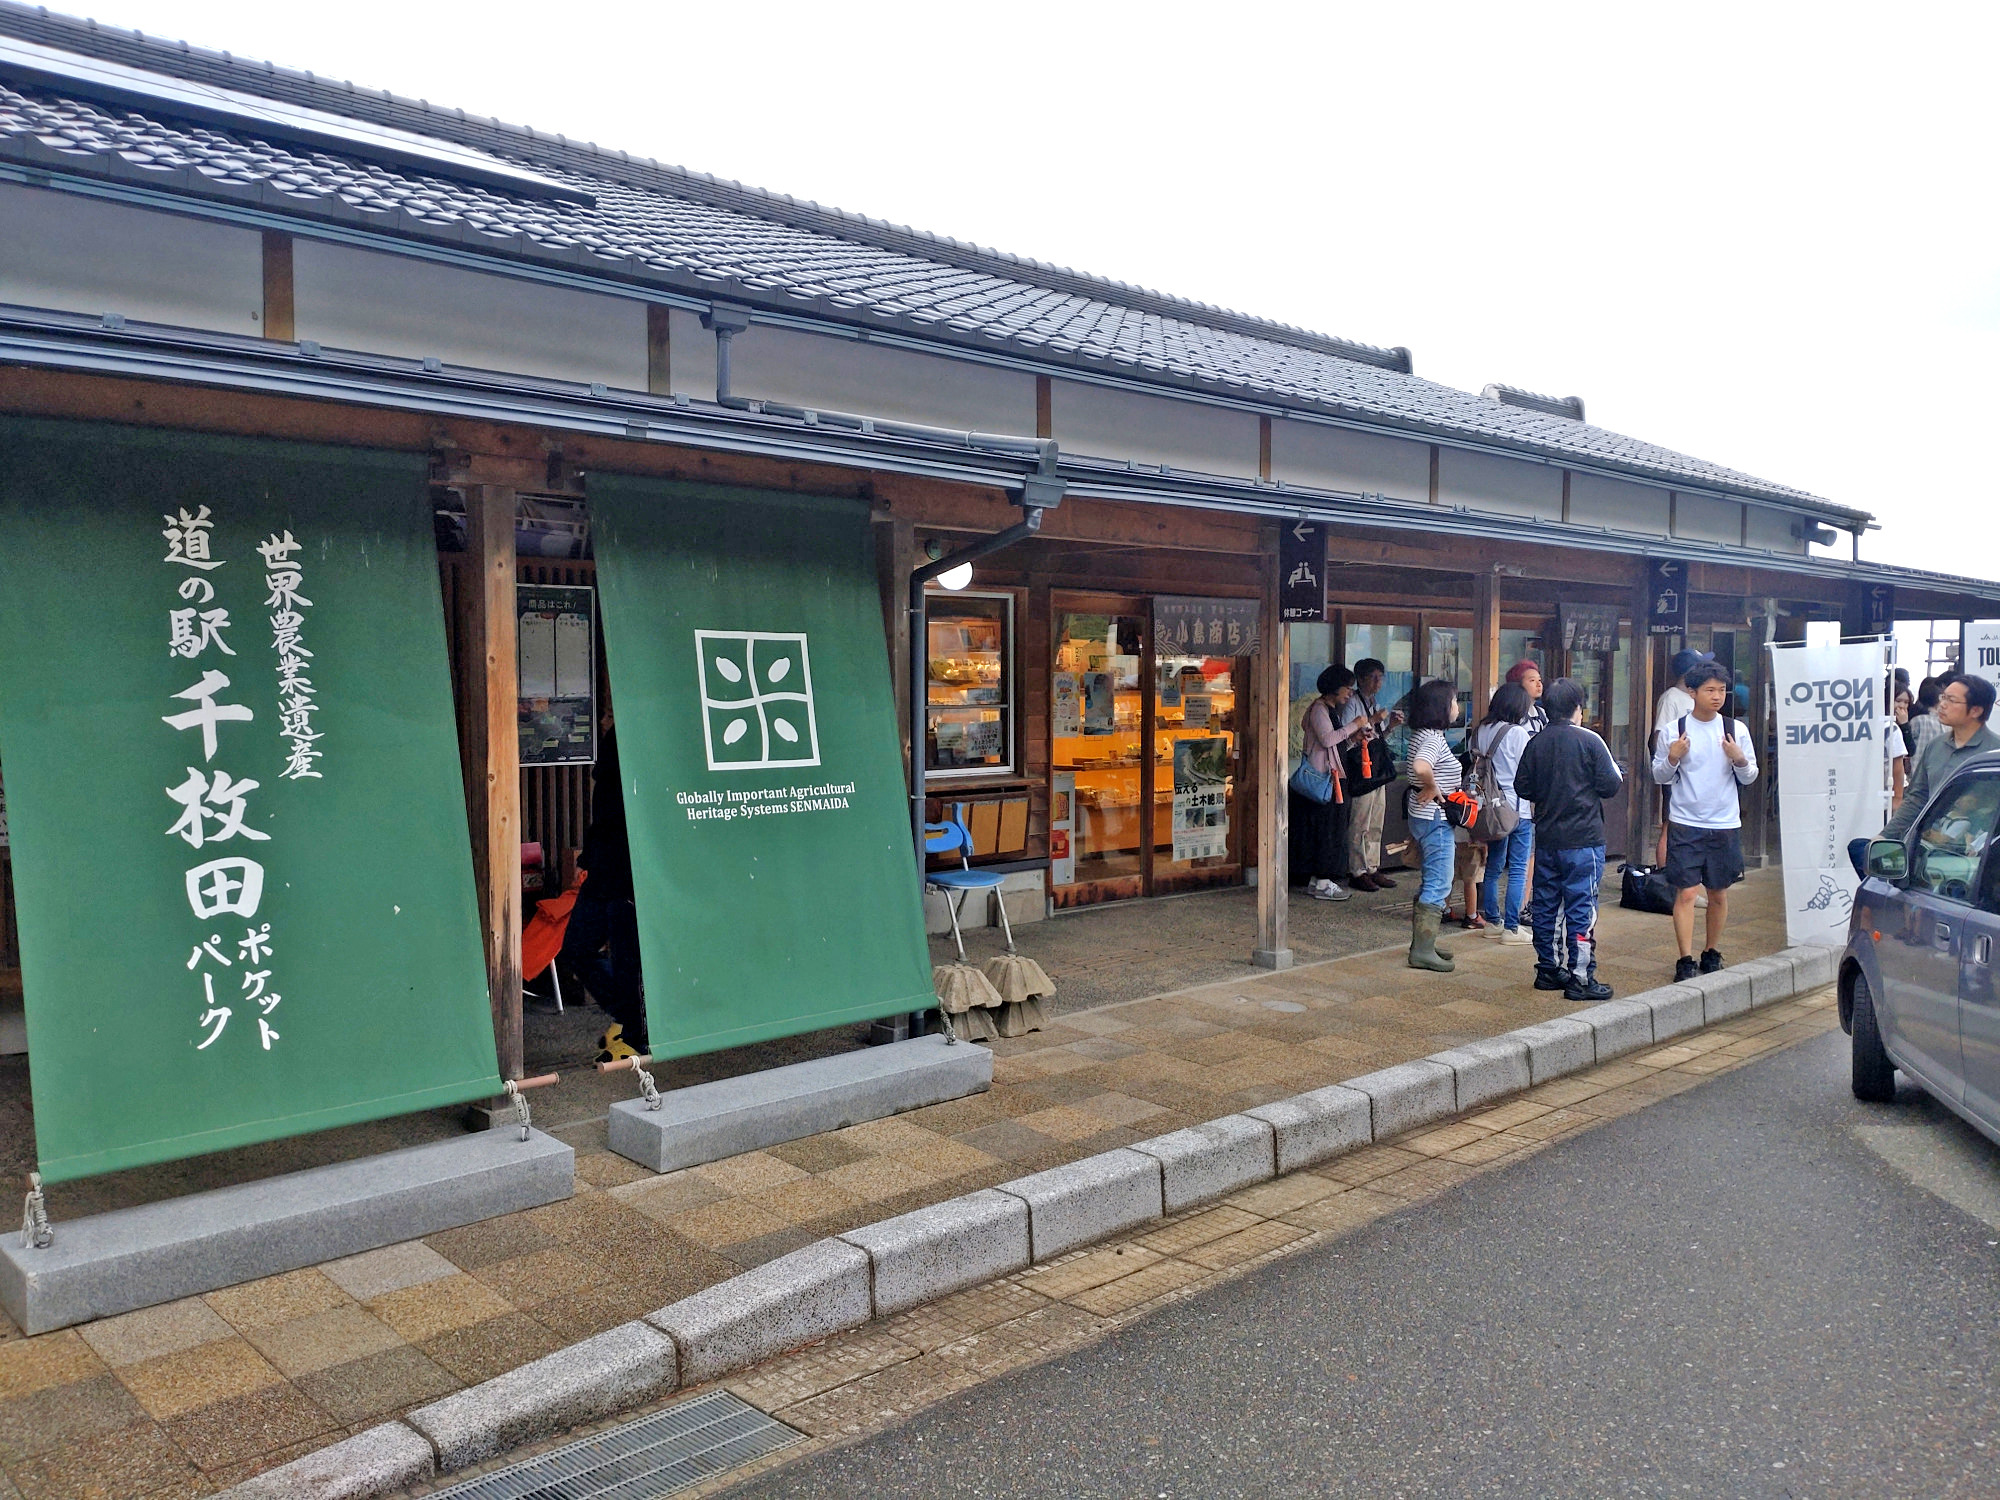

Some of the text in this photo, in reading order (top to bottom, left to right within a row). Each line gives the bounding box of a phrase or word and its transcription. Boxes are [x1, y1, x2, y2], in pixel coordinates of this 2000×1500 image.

[162, 504, 272, 922] 道の駅 千枚田
[255, 530, 326, 780] 世界農業遺産
[676, 781, 856, 806] Globally Important Agricultural
[686, 796, 850, 821] Heritage Systems SENMAIDA
[186, 933, 233, 1050] パーク
[239, 922, 283, 1051] ポケット
